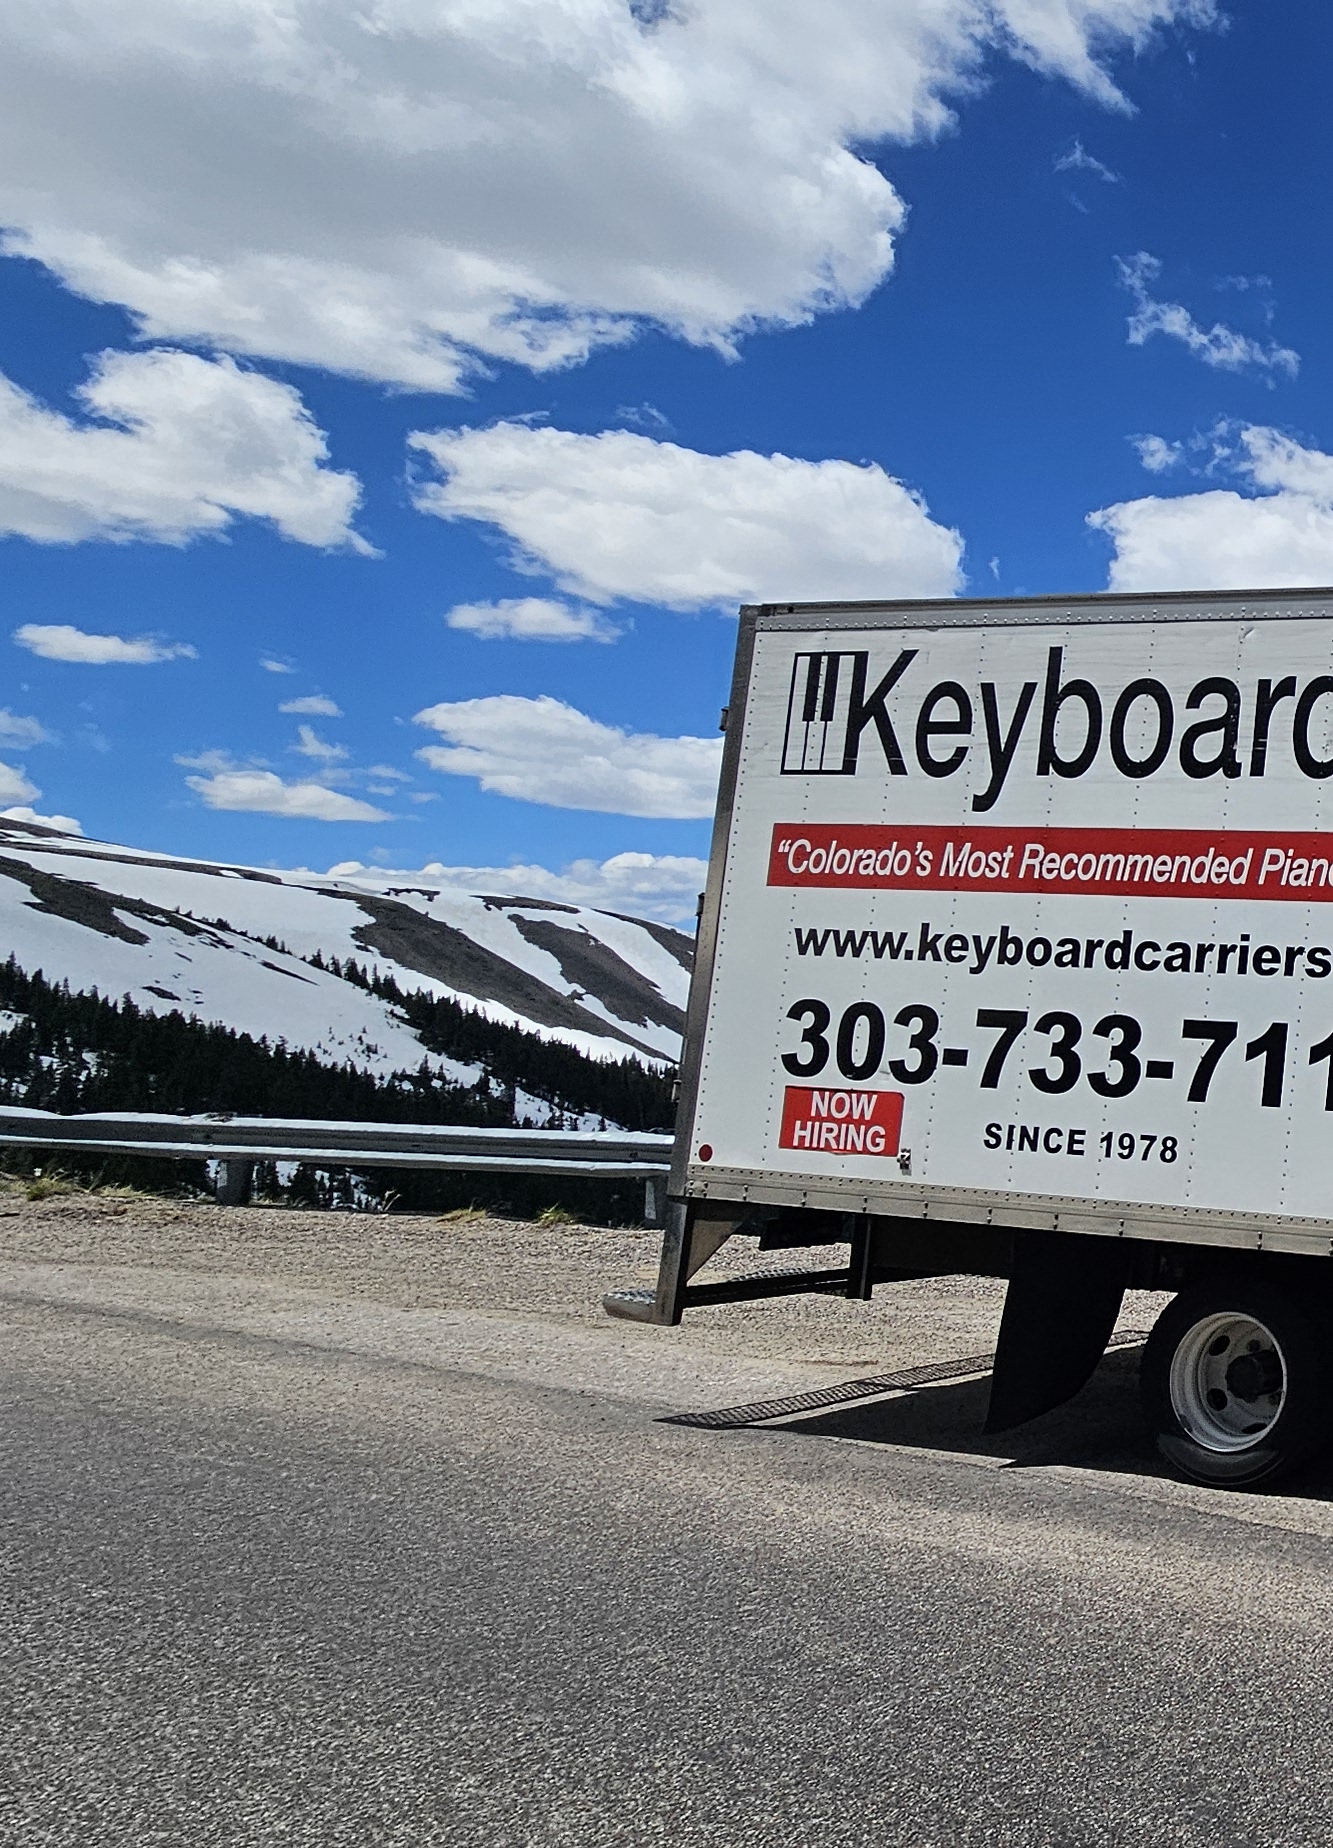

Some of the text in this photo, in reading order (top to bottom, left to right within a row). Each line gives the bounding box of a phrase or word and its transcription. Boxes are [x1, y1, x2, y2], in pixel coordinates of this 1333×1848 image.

[939, 843, 1014, 879] Most
[1019, 844, 1253, 885] Recommended
[811, 1090, 878, 1120] NOW
[792, 1120, 886, 1153] HIRING
[983, 1122, 1178, 1164] SINCE 1978
